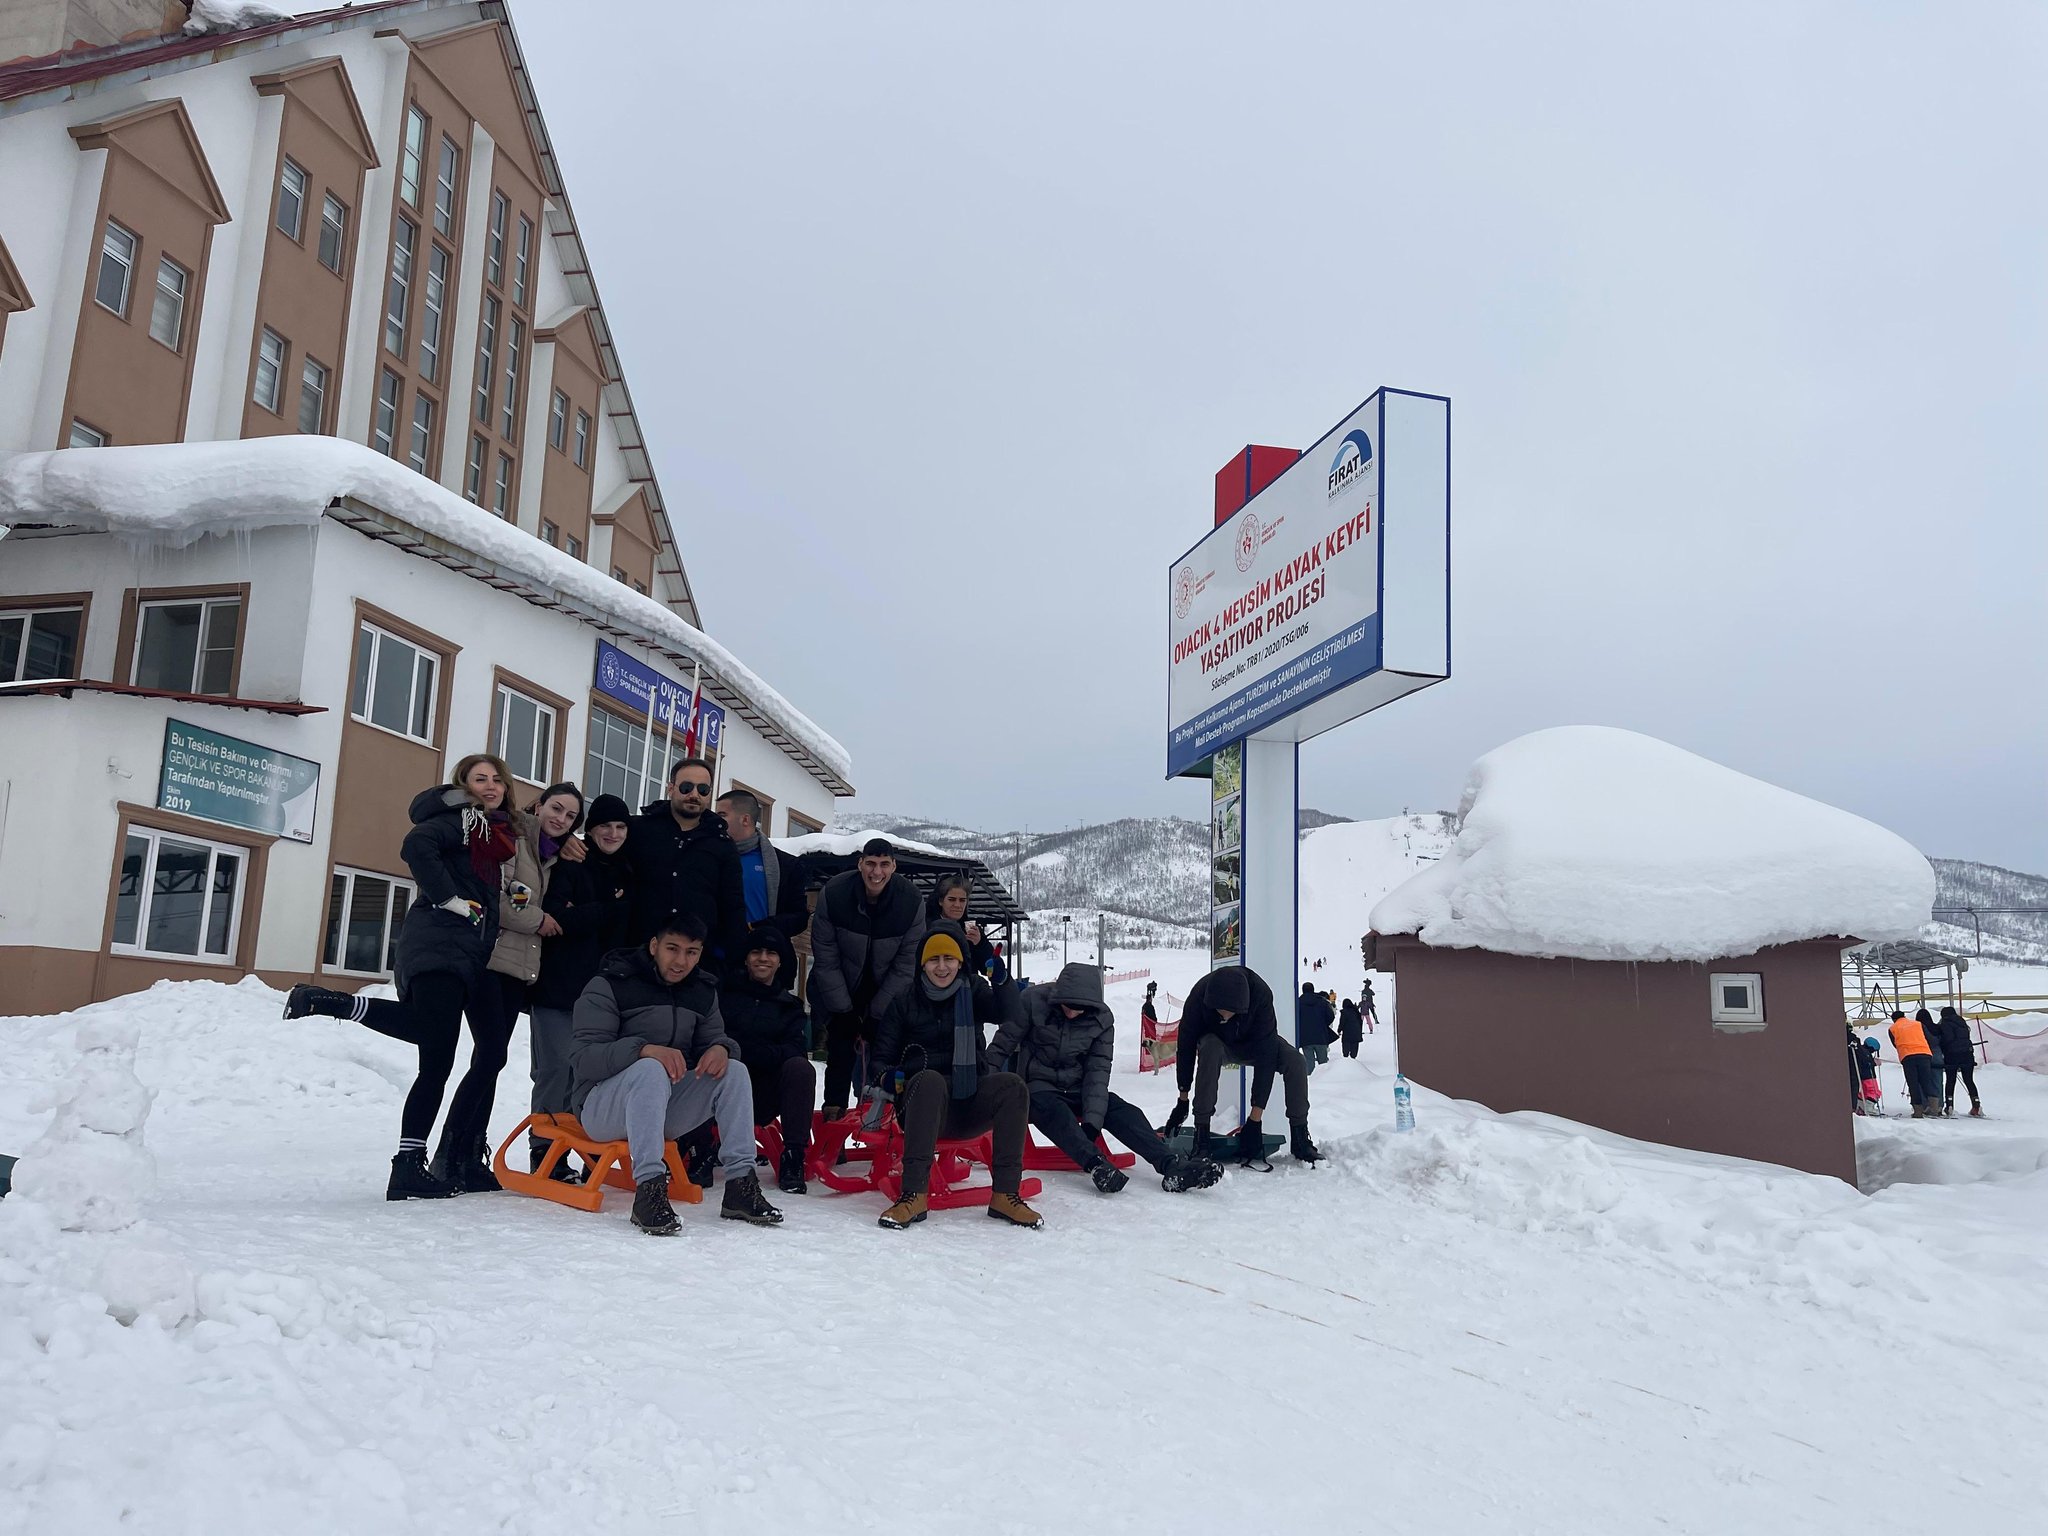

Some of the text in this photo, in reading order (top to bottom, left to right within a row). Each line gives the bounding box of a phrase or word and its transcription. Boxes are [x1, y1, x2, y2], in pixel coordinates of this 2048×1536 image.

[1328, 453, 1360, 490] FIRAT
[1328, 478, 1353, 498] KALKINMA
[1174, 621, 1211, 664] OVACIK
[1213, 614, 1220, 635] 4
[1223, 578, 1270, 631] MEVSİM
[1274, 541, 1321, 596] KAYAK
[1326, 502, 1370, 561] KEYFİ
[1201, 568, 1325, 675] YAŞATIYOR PROJESİ
[660, 681, 691, 709] OVACIK
[1270, 679, 1277, 690] ve
[659, 702, 687, 730] KAAK
[1206, 725, 1222, 742] Destek
[1282, 666, 1332, 702] Desteklenmiştir
[171, 732, 185, 747] Bu
[187, 736, 219, 756] Tesisin
[220, 746, 248, 765] Bakım
[249, 757, 259, 768] ve
[167, 767, 215, 791] Tarafından
[209, 760, 221, 775] VE
[222, 764, 246, 781] SPOR
[165, 795, 191, 811] 2019
[166, 785, 181, 795] Ekim
